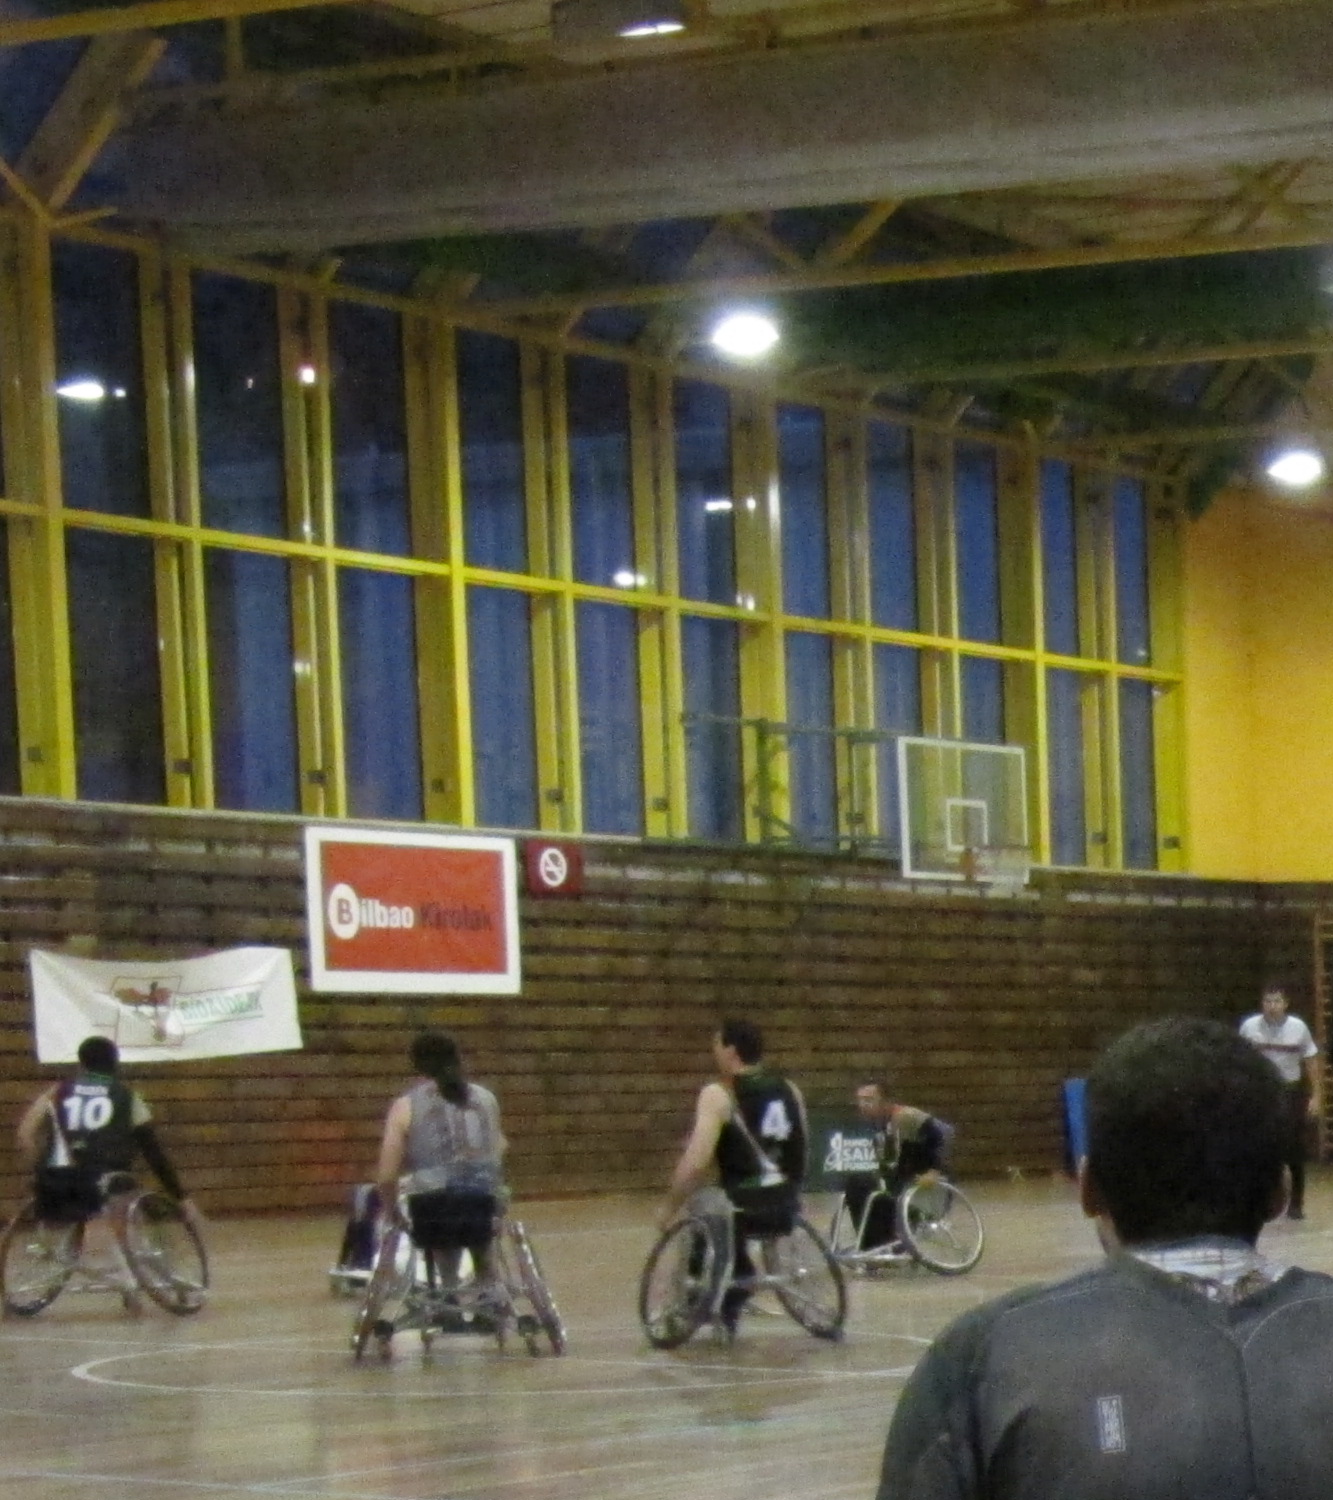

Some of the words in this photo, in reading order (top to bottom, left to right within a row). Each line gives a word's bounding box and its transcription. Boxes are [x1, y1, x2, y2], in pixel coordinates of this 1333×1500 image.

[337, 896, 414, 928] Bilbao
[420, 901, 492, 931] Kirolak
[63, 1095, 114, 1131] 10
[761, 1100, 792, 1141] 4
